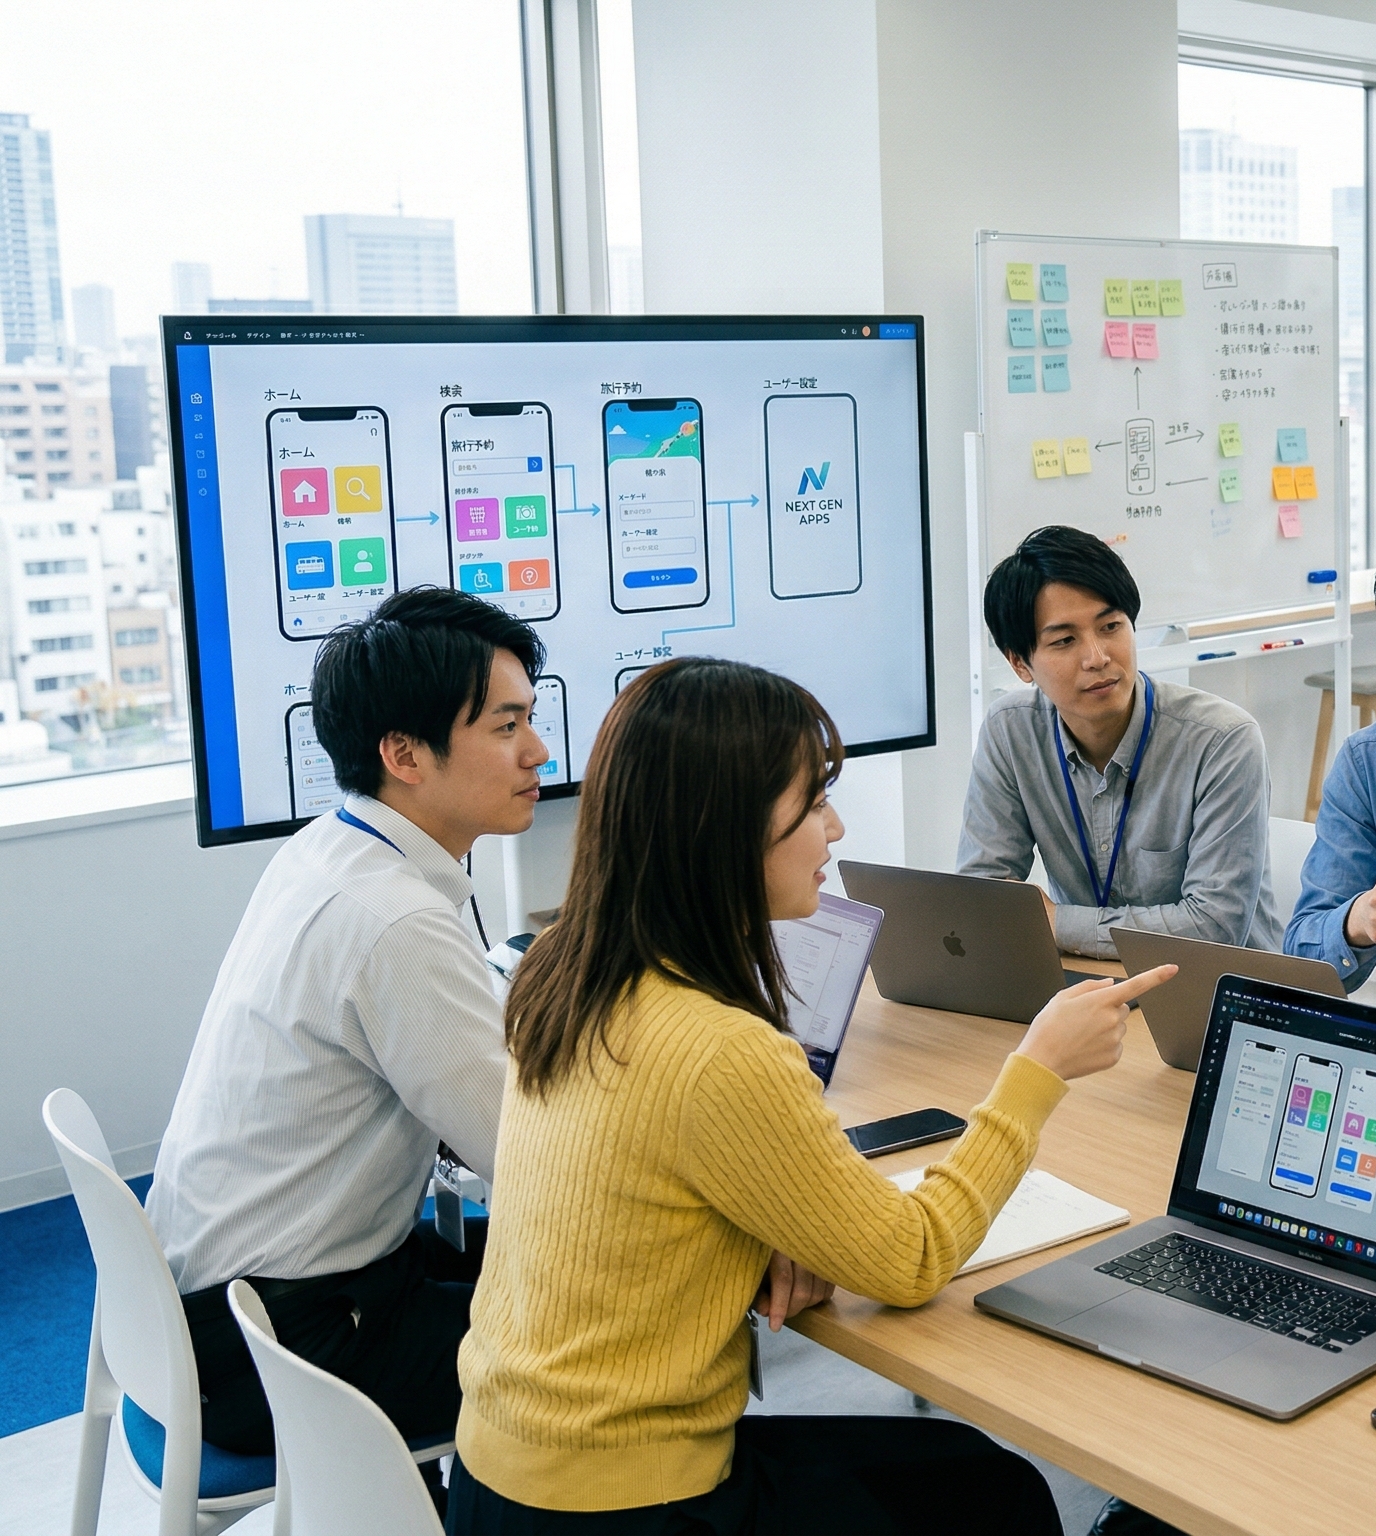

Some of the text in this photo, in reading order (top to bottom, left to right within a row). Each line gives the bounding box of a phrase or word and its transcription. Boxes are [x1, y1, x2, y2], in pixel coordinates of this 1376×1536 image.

[264, 388, 302, 401] ホーム
[279, 446, 315, 460] ホーム
[785, 499, 843, 512] NEXT GEN
[799, 513, 830, 525] APPS
[284, 684, 311, 696] ホー
